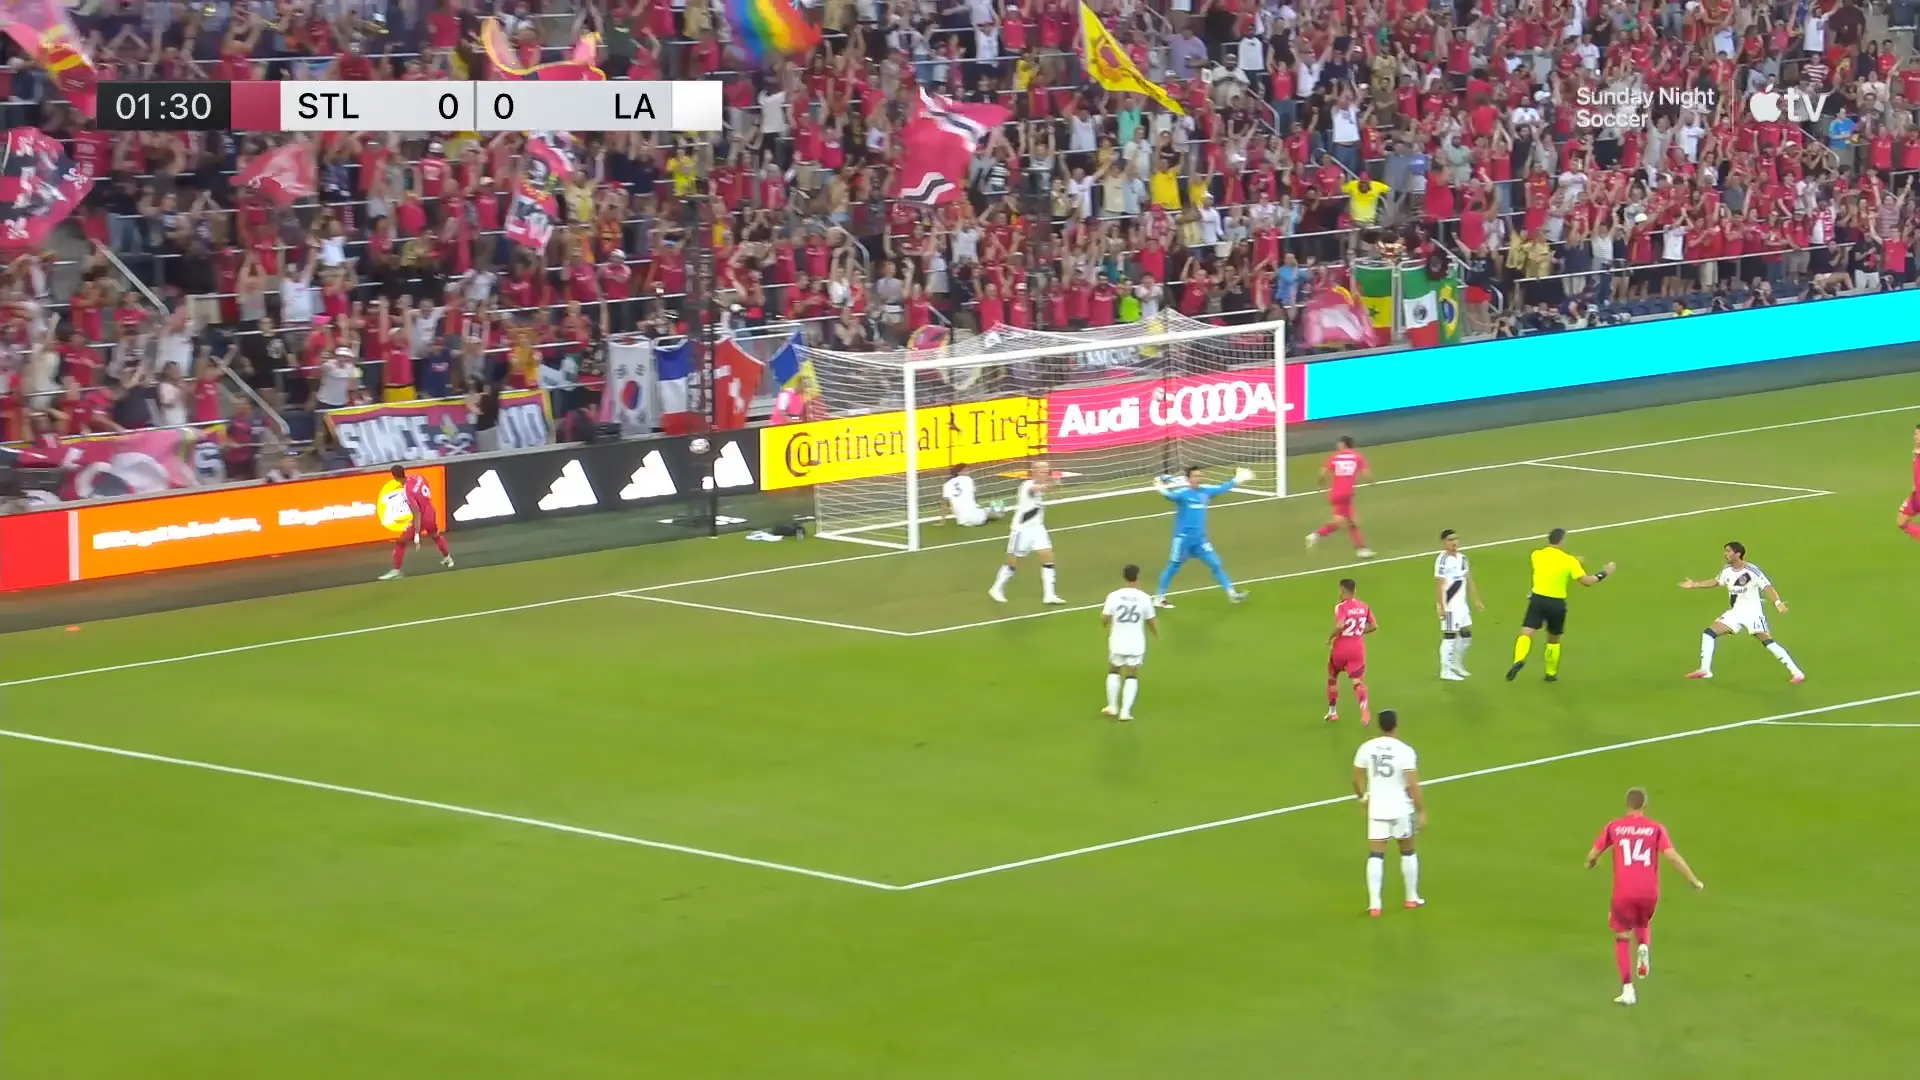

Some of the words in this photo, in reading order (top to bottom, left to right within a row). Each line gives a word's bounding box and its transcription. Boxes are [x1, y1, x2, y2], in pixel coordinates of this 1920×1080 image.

[1057, 396, 1141, 438] Audi
[337, 414, 440, 466] SINCE
[785, 415, 940, 477] Continenal
[969, 409, 1029, 445] Tire
[1116, 604, 1141, 624] 26
[1341, 616, 1367, 637] 23
[1370, 754, 1395, 778] 15
[1618, 838, 1652, 867] 14
